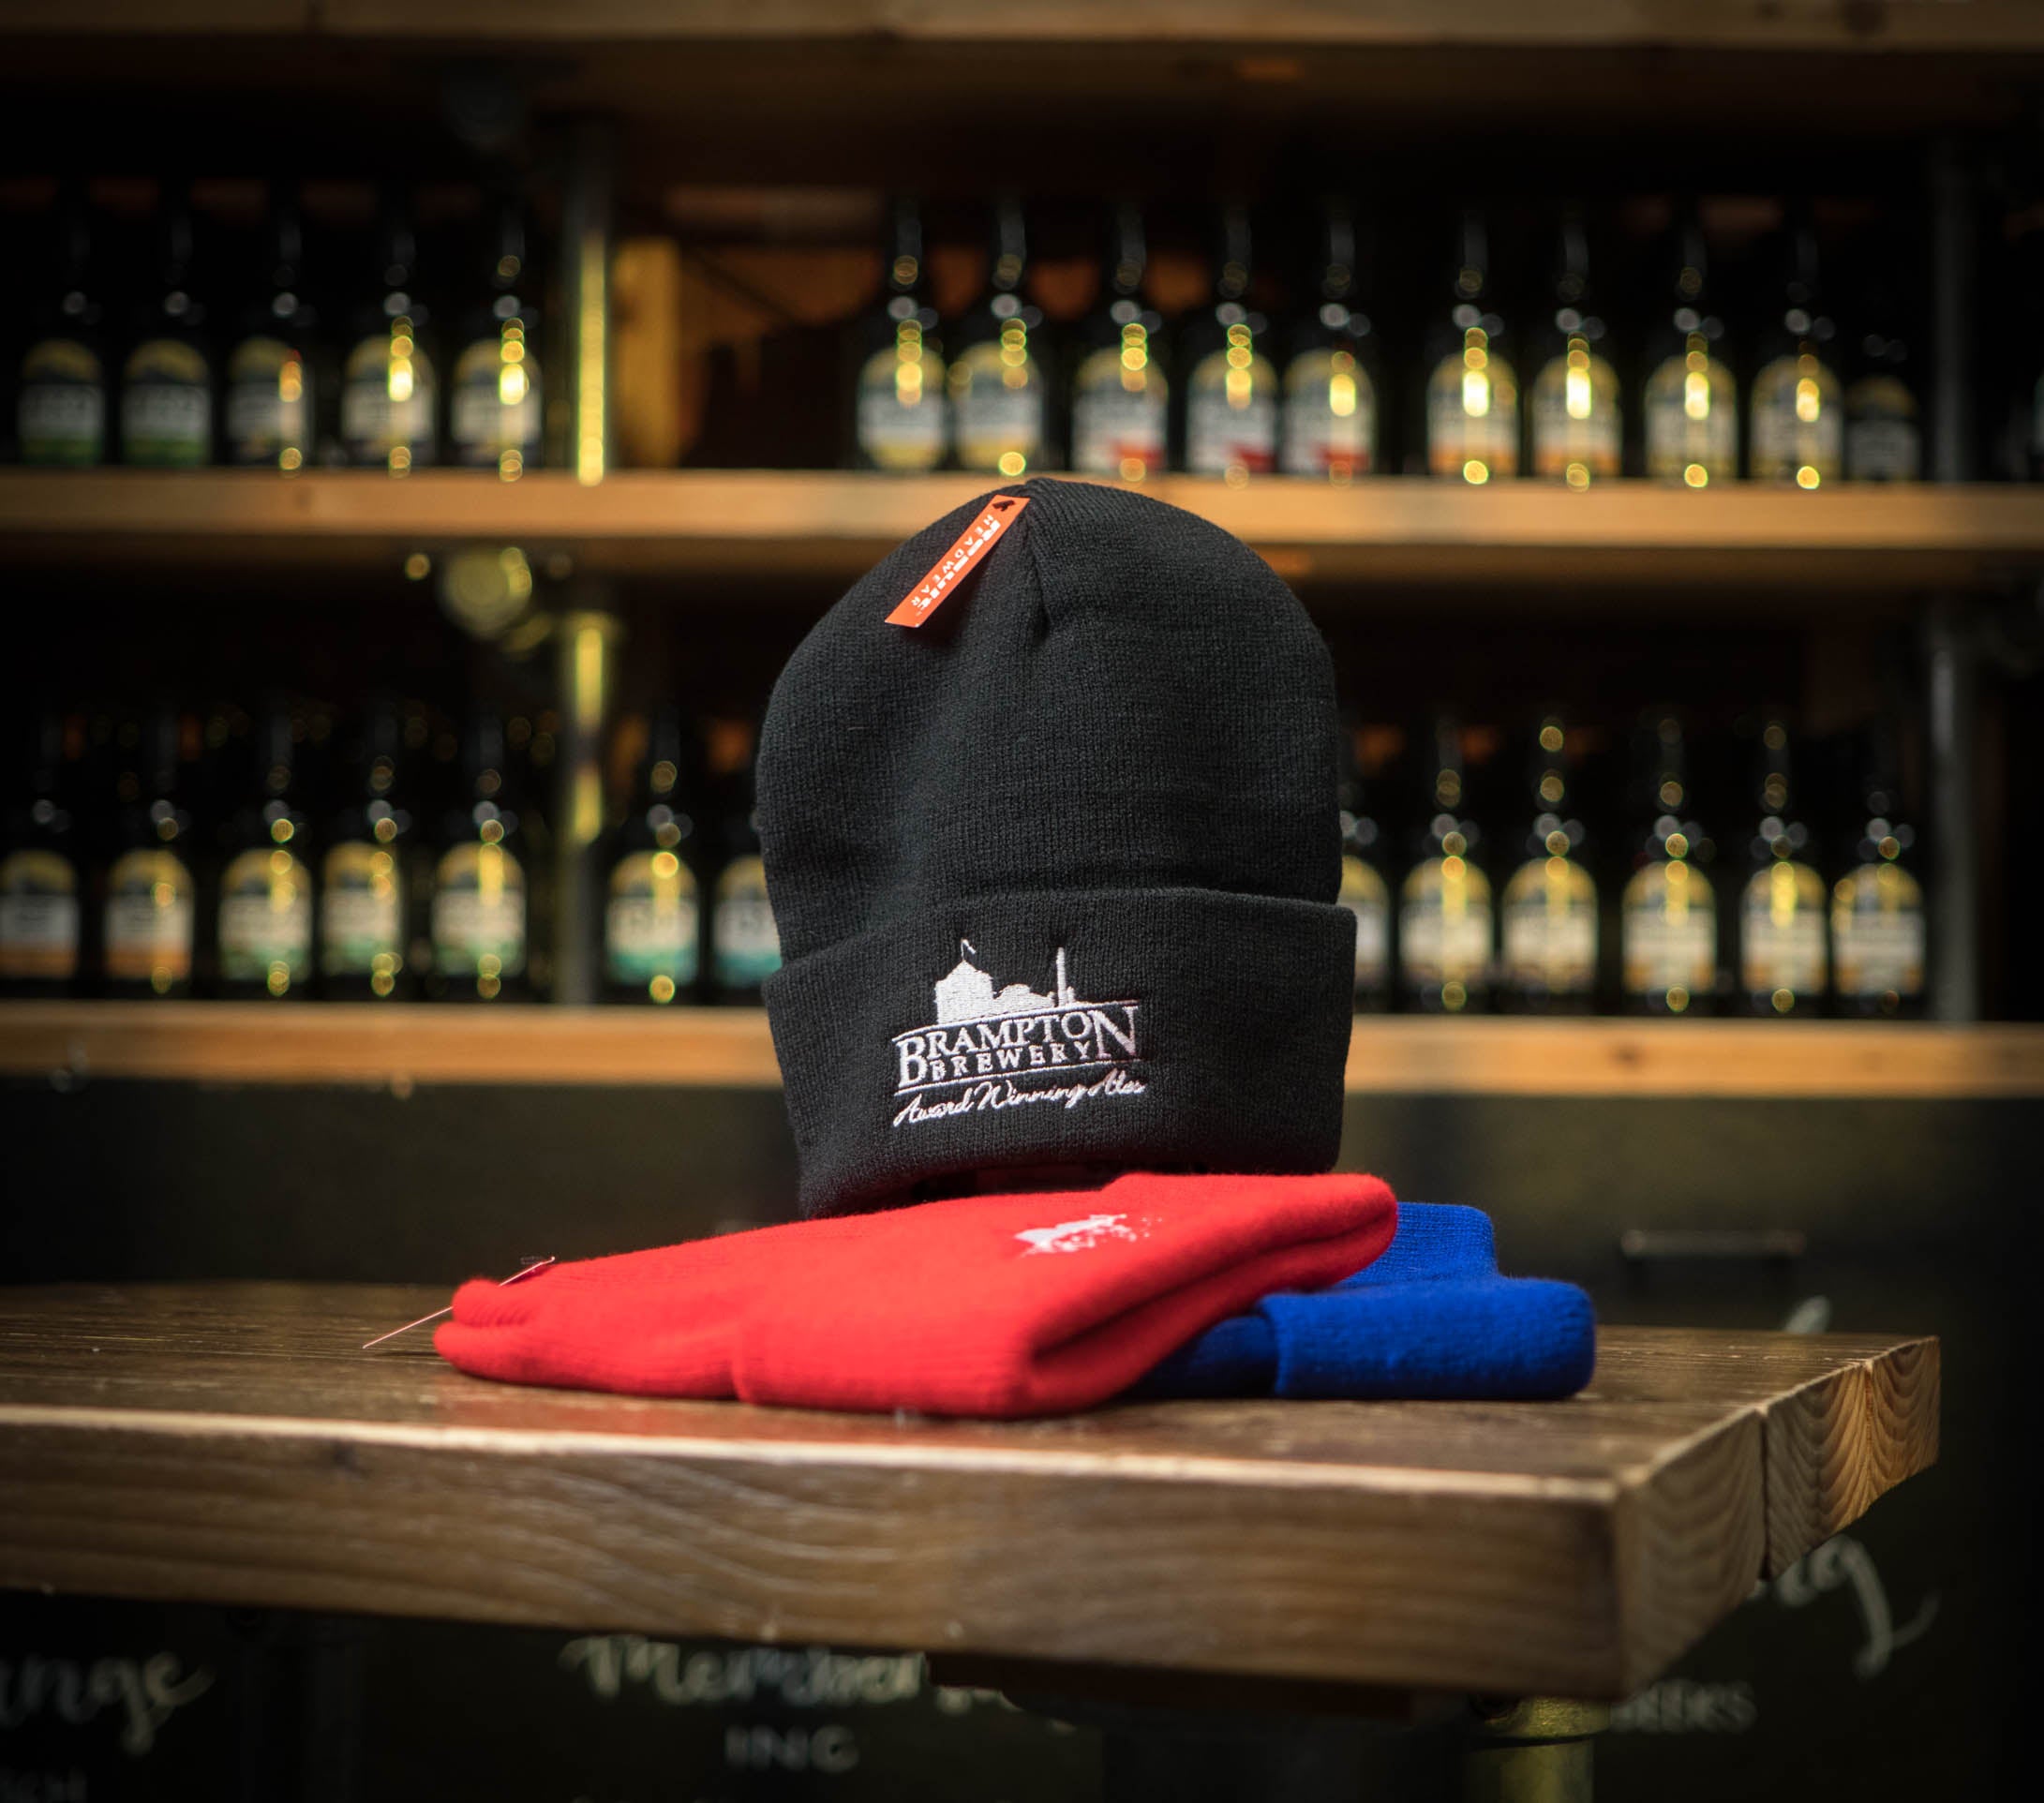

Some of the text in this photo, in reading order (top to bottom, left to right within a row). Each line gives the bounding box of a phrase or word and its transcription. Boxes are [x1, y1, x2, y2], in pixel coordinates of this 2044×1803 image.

[911, 514, 993, 606] HEADWEAR
[896, 1006, 1139, 1089] BRAMPTON
[930, 1041, 1091, 1081] BREWERY
[893, 1068, 1145, 1126] Award Winning Ales
